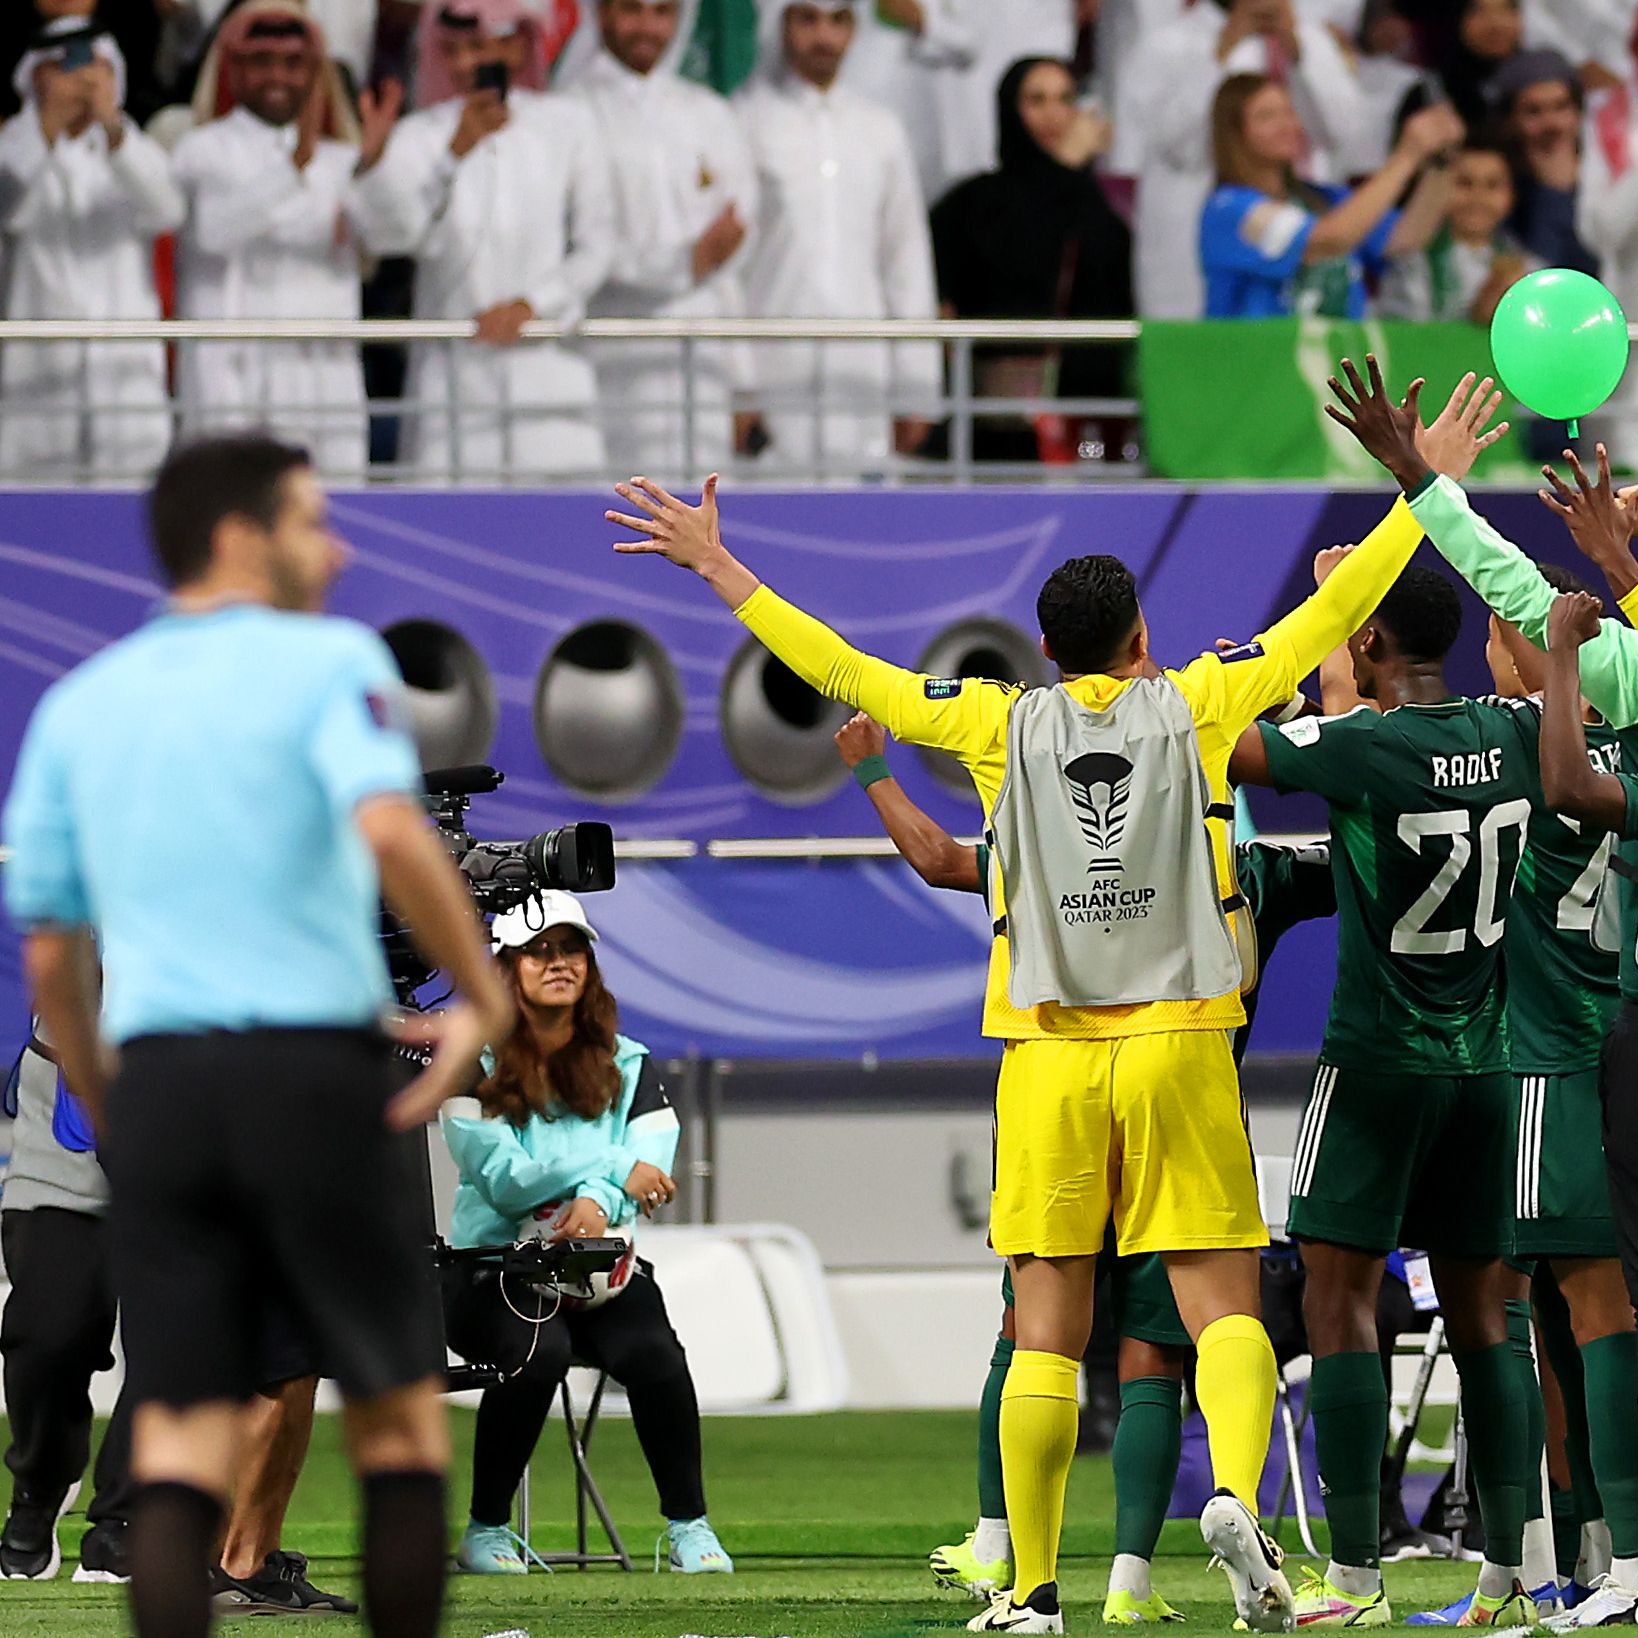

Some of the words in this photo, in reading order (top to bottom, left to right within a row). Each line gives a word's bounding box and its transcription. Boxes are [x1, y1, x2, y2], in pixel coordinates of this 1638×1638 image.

[1431, 747, 1502, 787] RADIF
[1092, 878, 1121, 891] AFC
[1391, 798, 1531, 954] 20
[1059, 892, 1116, 909] ASIAN
[1120, 888, 1156, 906] CUP
[1064, 909, 1112, 926] QATAR
[1116, 905, 1148, 921] 2023
